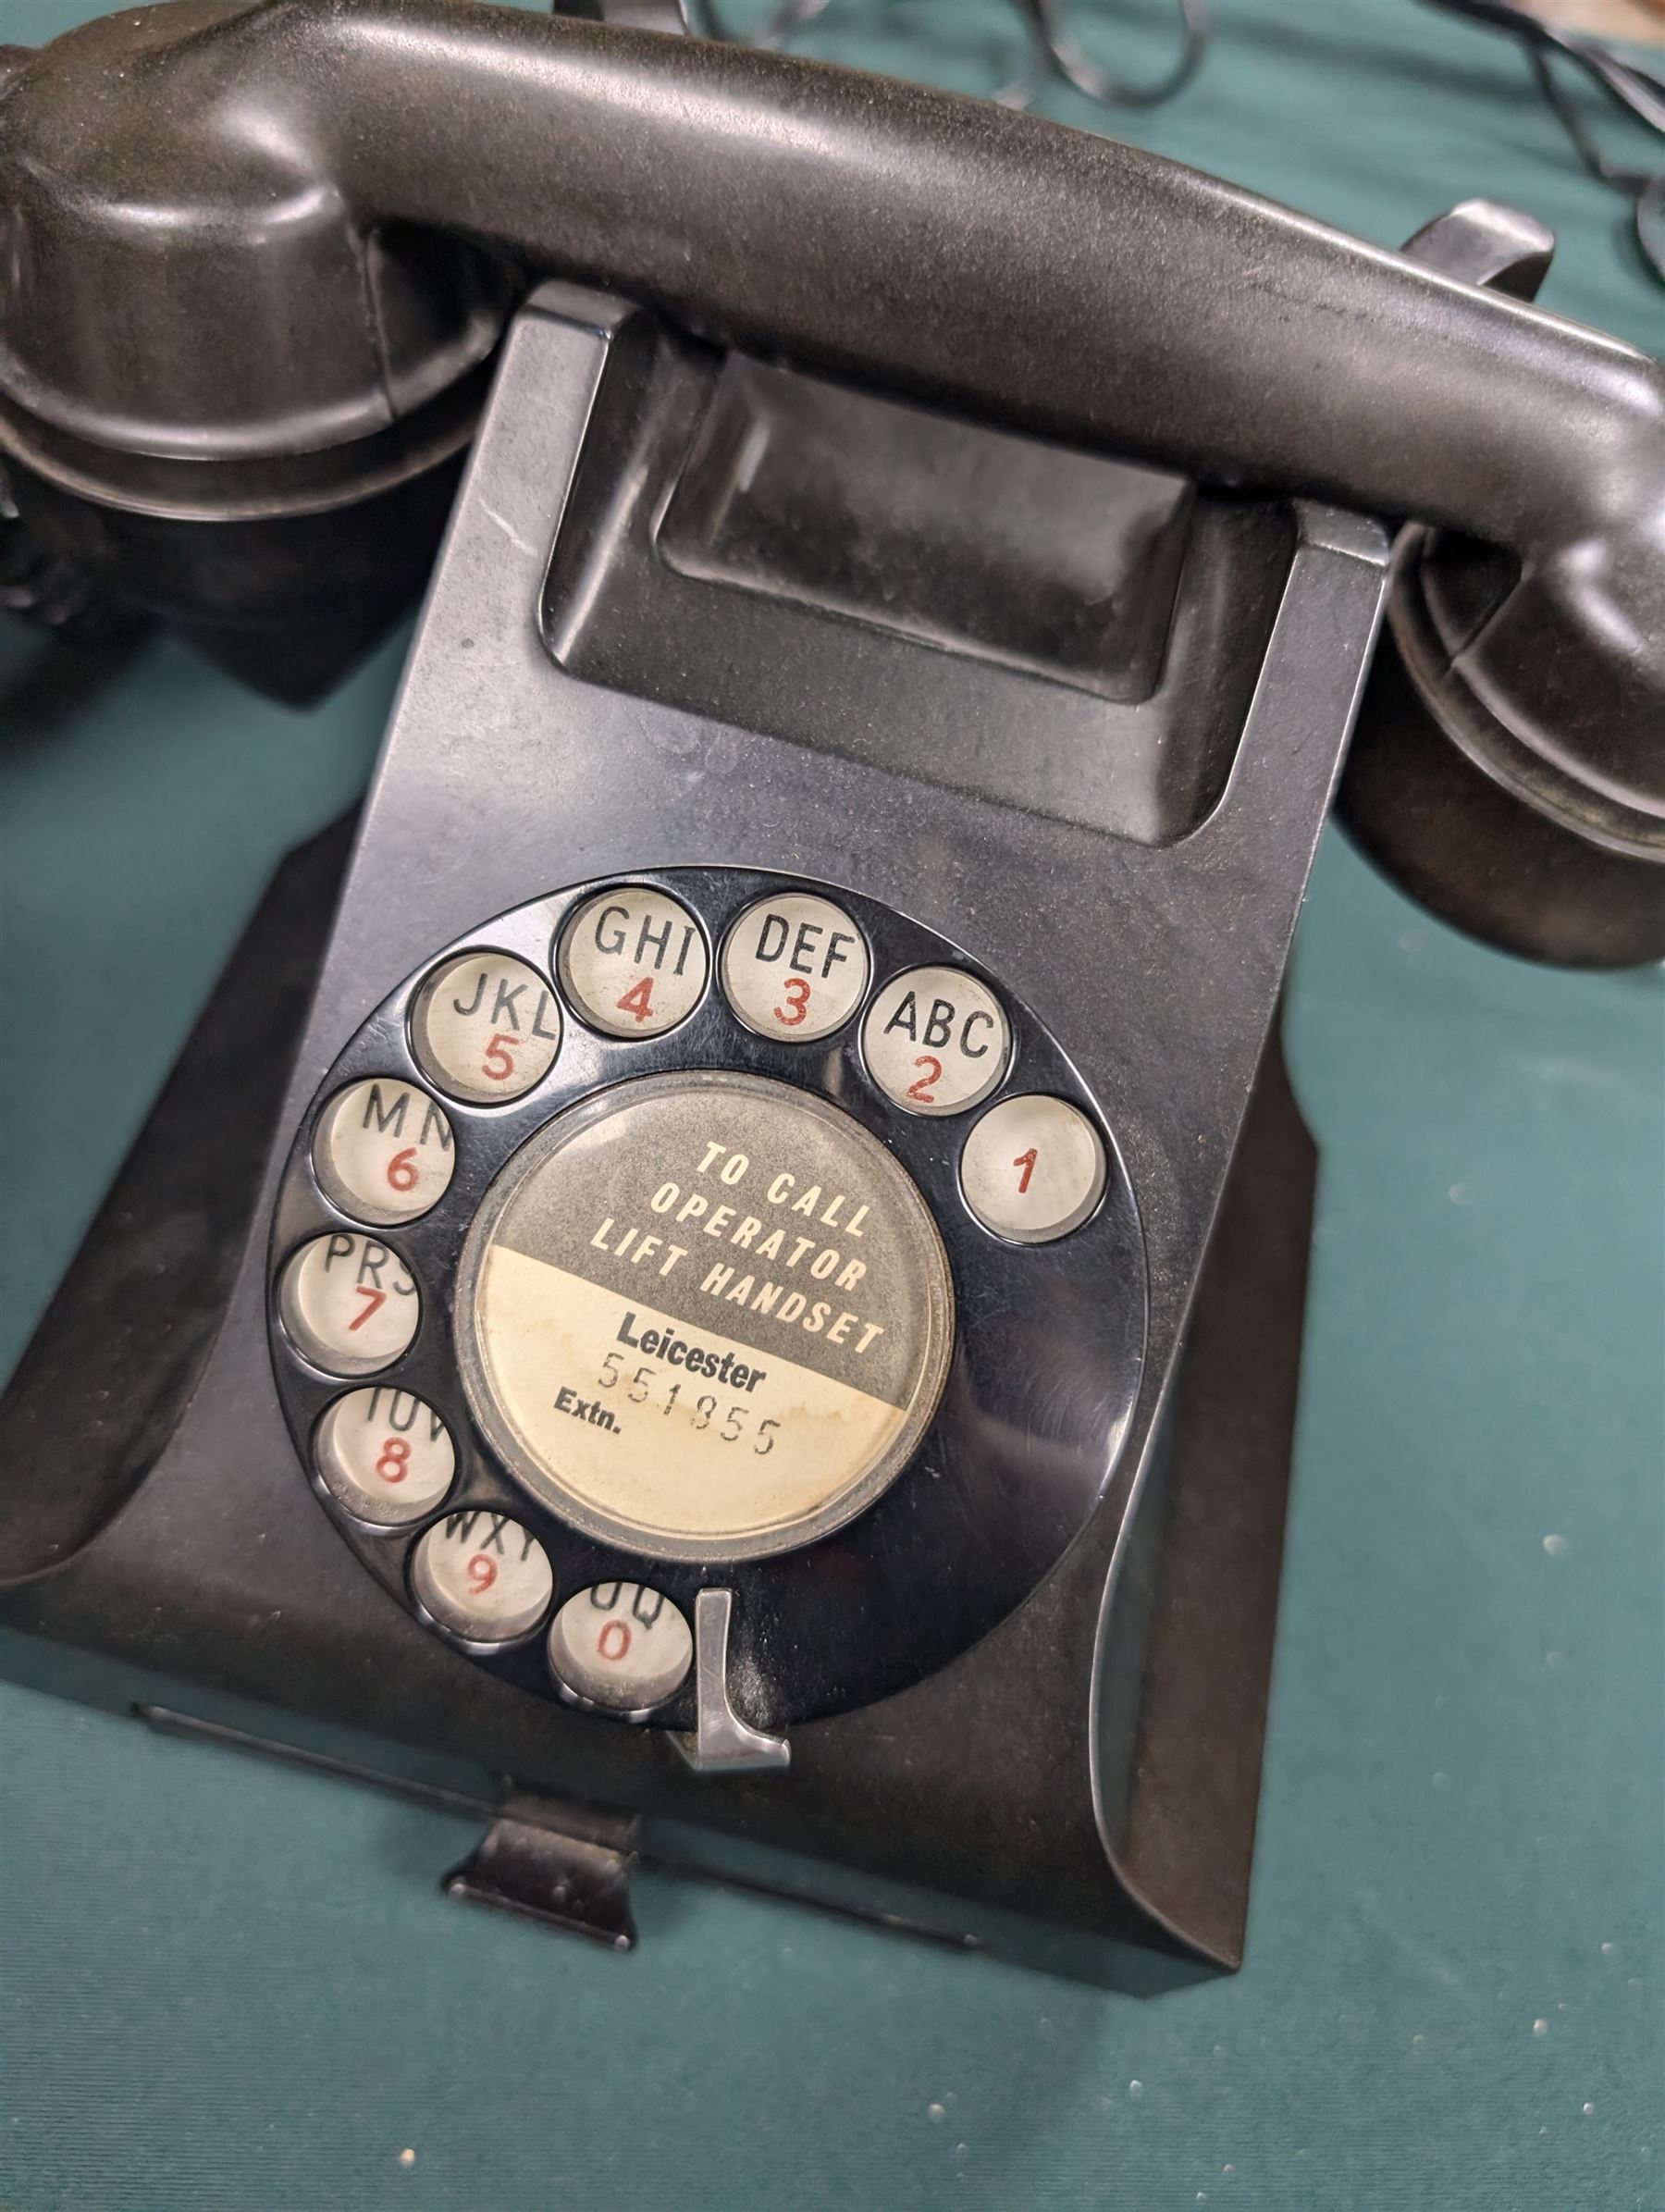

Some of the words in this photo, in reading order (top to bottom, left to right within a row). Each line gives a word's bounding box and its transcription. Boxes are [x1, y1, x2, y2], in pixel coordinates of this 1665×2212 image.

[595, 906, 697, 976] GHI
[755, 913, 856, 979] DEF
[452, 972, 556, 1042] JKL
[616, 977, 654, 1023] 4
[773, 977, 811, 1026] 3
[883, 990, 994, 1059] ABC
[481, 1033, 521, 1081] 5
[906, 1055, 943, 1103] 2
[387, 1147, 420, 1193] 6
[696, 1141, 749, 1186] TO
[766, 1172, 871, 1238] CALL
[1012, 1147, 1038, 1194] 1
[650, 1181, 868, 1292] OPERATOR
[348, 1284, 387, 1331] 7
[589, 1217, 688, 1278] LIFT
[700, 1261, 885, 1355] HANDSET
[616, 1310, 767, 1393] Leicester
[552, 1385, 623, 1435] Extn.
[375, 1436, 413, 1484] 8
[467, 1553, 500, 1595] 9
